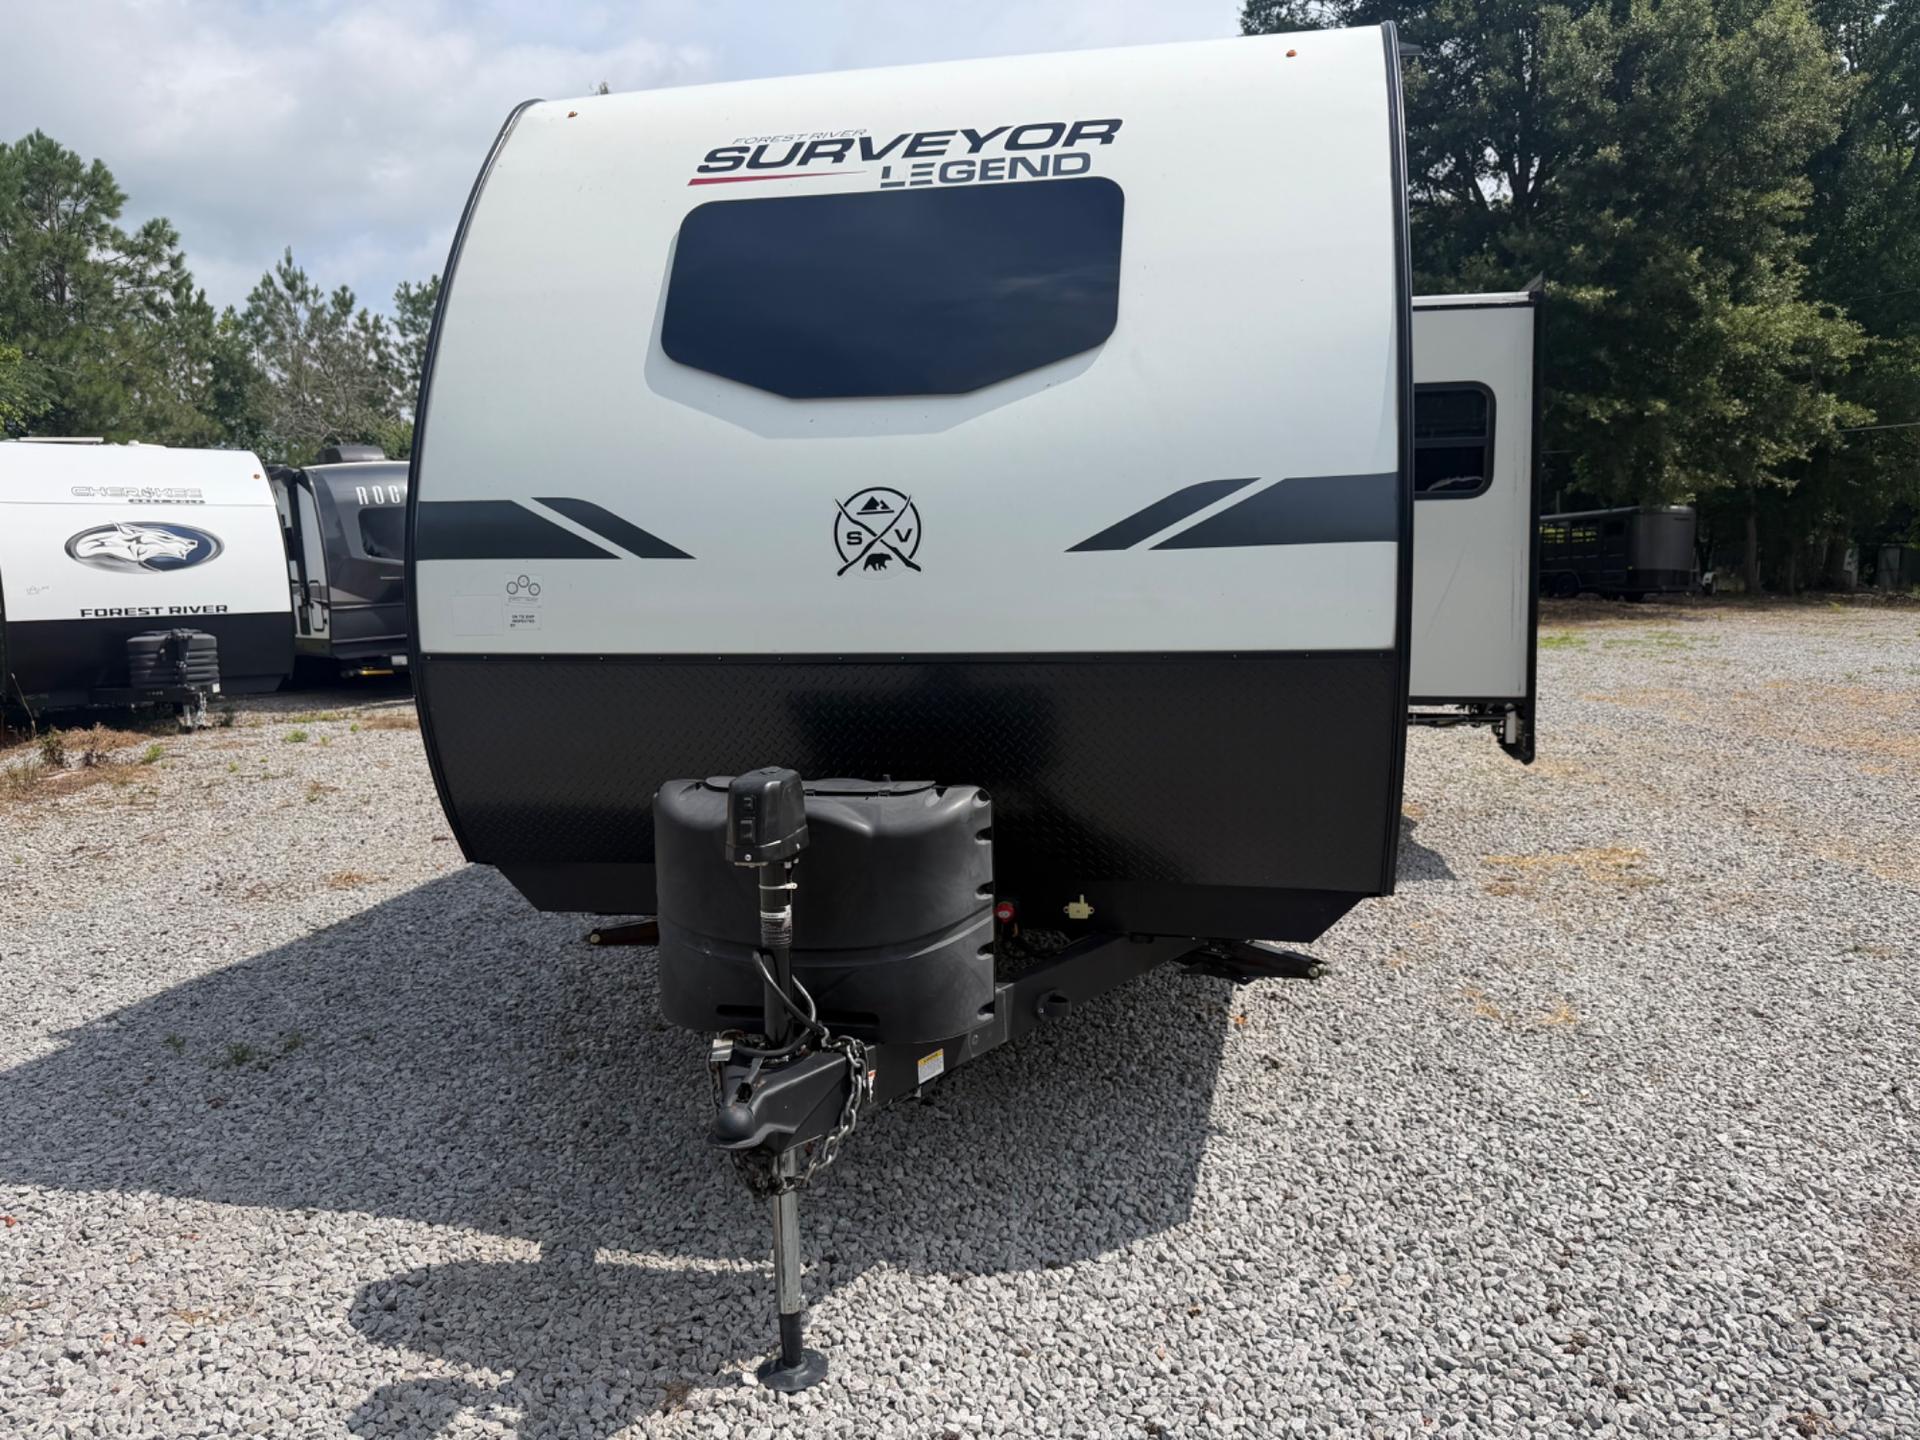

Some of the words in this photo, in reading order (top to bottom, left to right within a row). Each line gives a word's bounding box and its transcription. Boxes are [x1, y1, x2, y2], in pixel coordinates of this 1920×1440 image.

[732, 133, 811, 145] FOREST
[809, 128, 868, 140] RIVER
[697, 119, 1123, 173] SURVEYOR
[880, 152, 1091, 189] LEGEND
[355, 485, 408, 505] ROC
[847, 531, 862, 545] S
[895, 528, 912, 542] V
[80, 607, 164, 617] FOREST
[168, 605, 228, 614] RIVER
